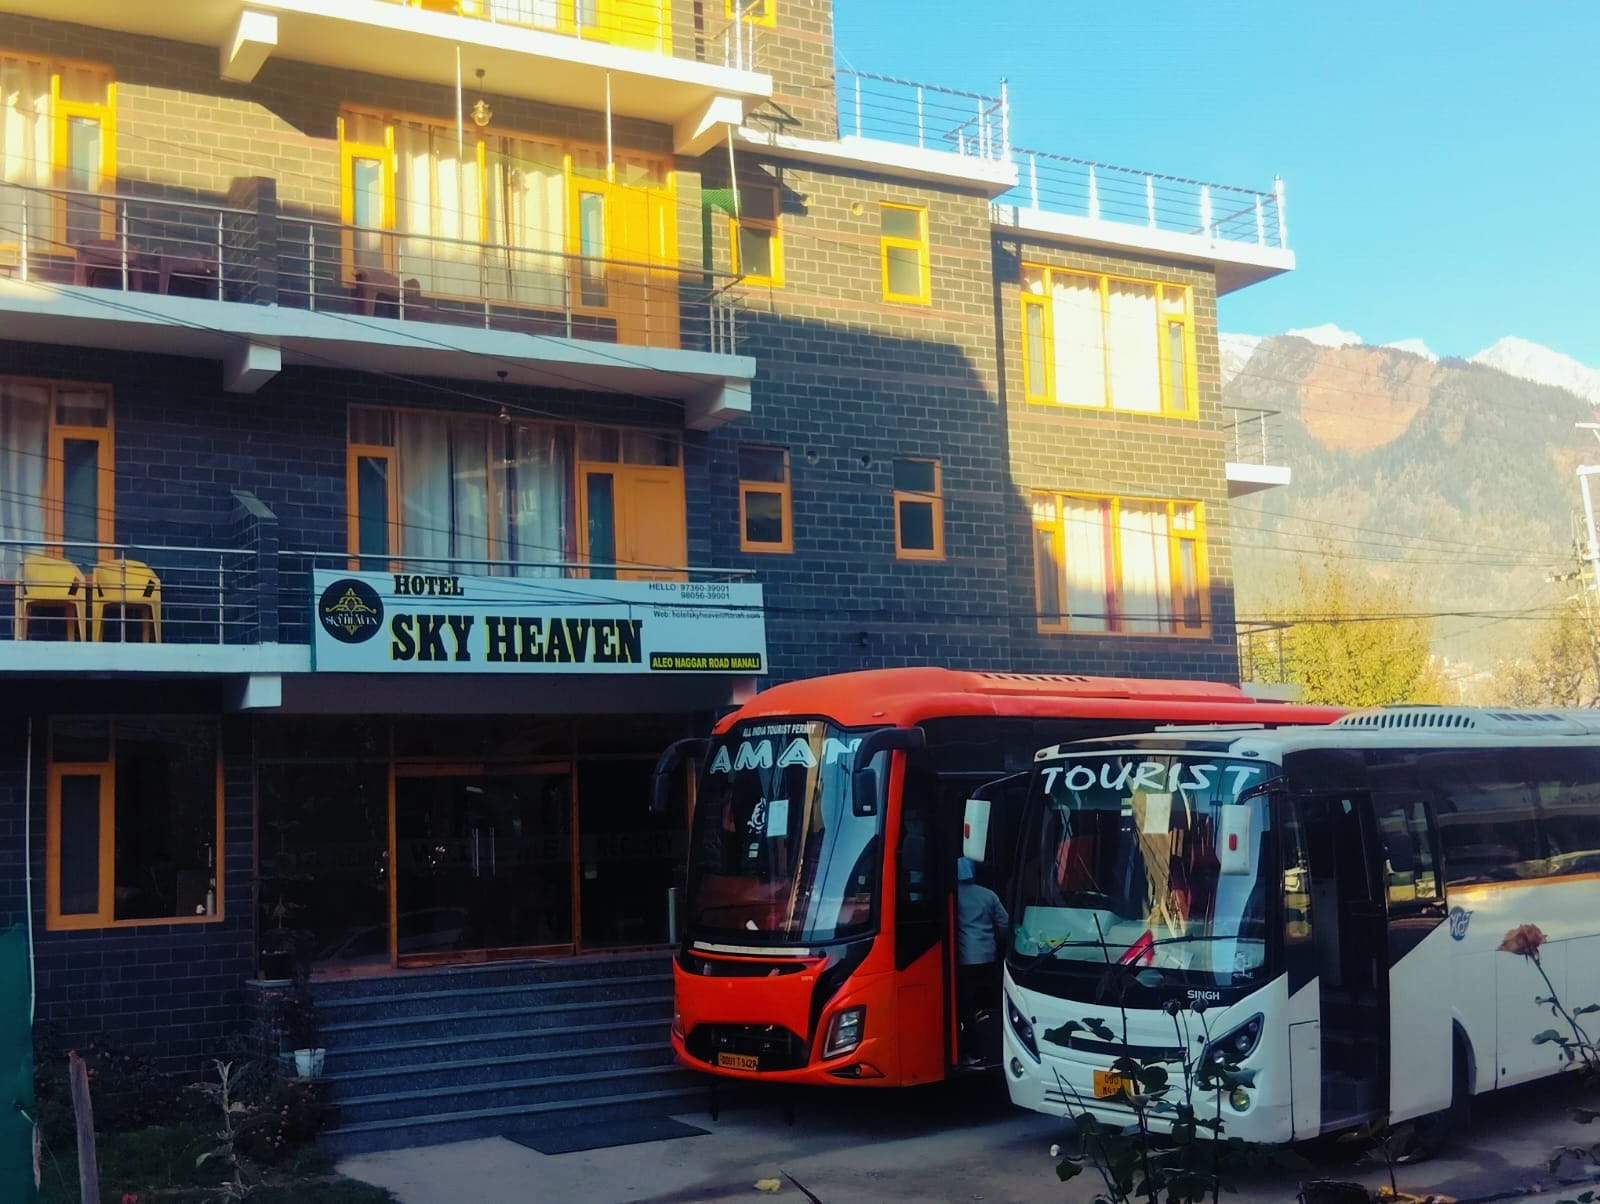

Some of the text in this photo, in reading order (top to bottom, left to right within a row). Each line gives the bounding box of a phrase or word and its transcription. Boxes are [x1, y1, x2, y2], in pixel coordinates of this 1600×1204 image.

[393, 574, 464, 596] HOTEL
[391, 613, 643, 664] SKY HEAVEN
[652, 656, 760, 669] ALEO NAGGAR ROAD MANALI
[767, 724, 791, 736] TOURIST
[791, 724, 816, 734] PERMIT
[710, 738, 863, 774] AMAN
[1041, 761, 1260, 795] TOURIST
[1186, 989, 1220, 1001] SINGH
